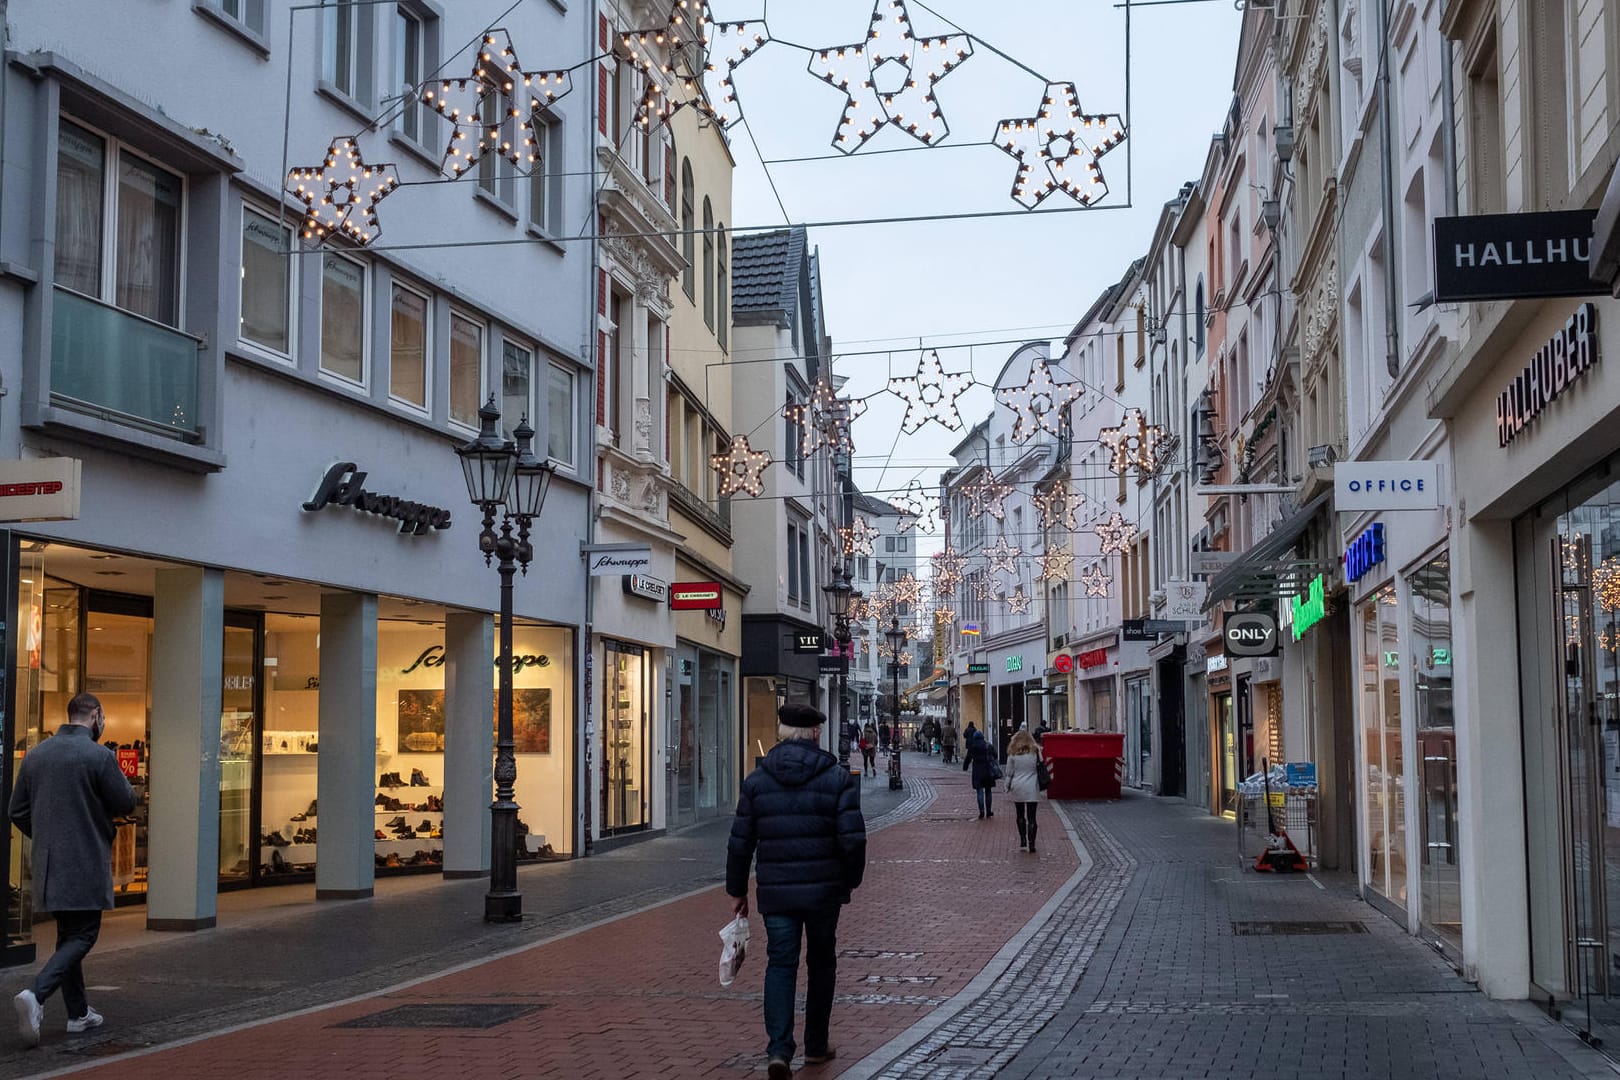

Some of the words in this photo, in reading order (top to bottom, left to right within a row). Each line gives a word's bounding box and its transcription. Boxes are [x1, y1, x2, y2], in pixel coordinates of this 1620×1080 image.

[1496, 302, 1598, 448] HALLHUBER
[1348, 479, 1425, 492] OFFICE
[639, 580, 645, 589] LE
[645, 581, 665, 596] CREUSET
[800, 636, 819, 645] VIU
[1228, 628, 1273, 640] ONLY
